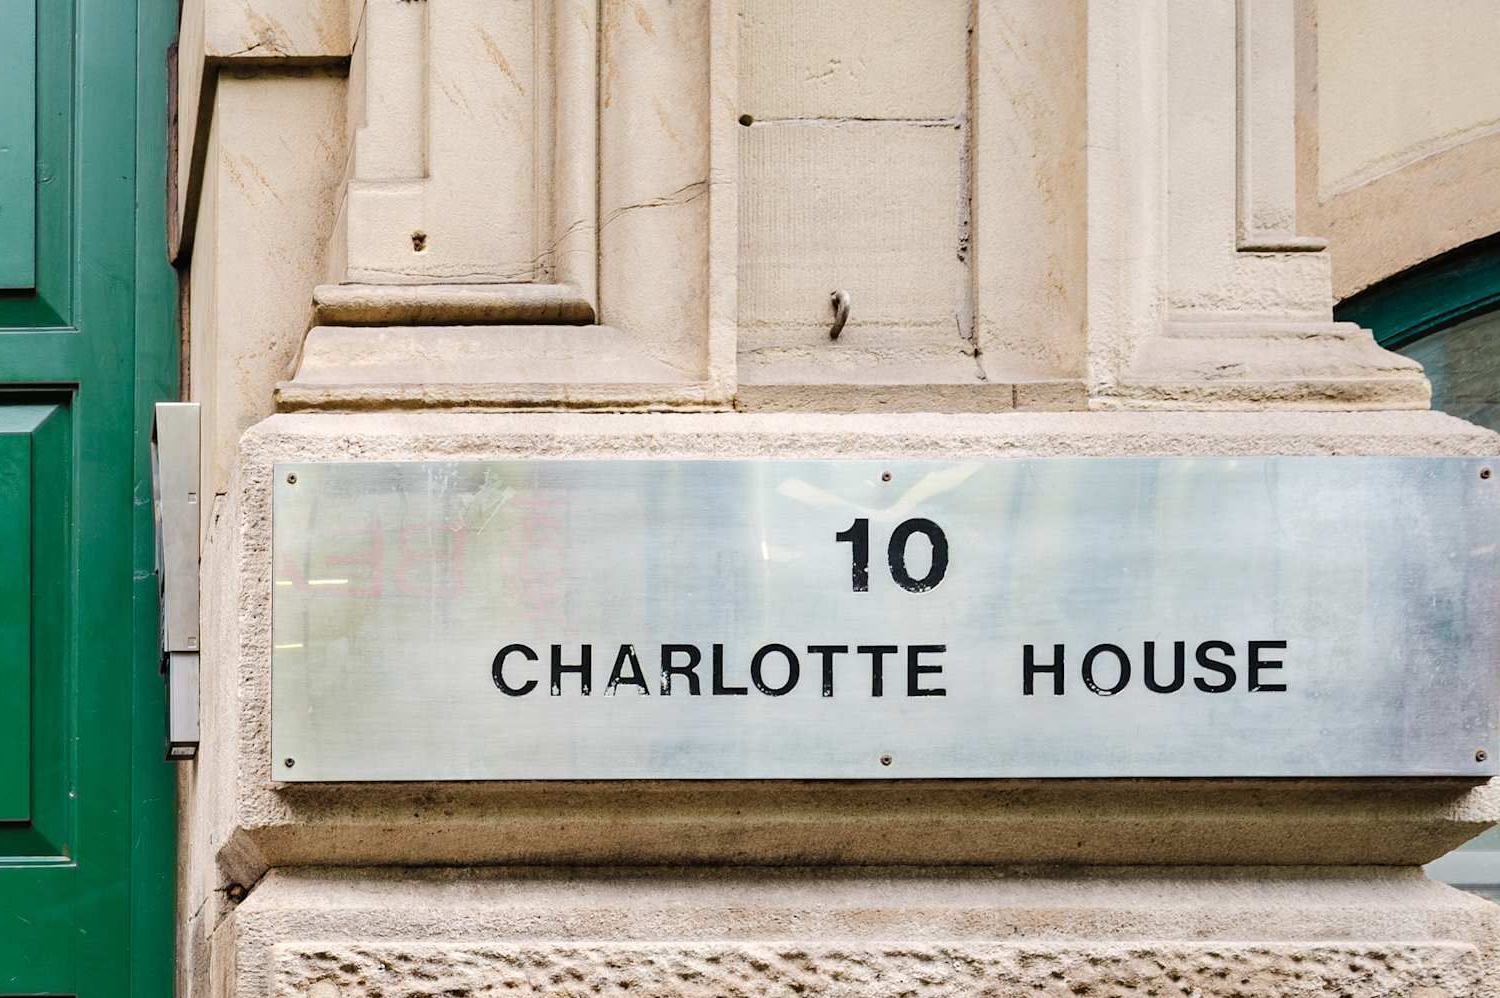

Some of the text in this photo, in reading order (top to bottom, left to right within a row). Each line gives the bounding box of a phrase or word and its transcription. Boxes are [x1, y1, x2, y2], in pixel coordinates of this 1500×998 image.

[834, 517, 950, 594] 10
[490, 640, 1288, 698] CHARLOTTE HOUSE
